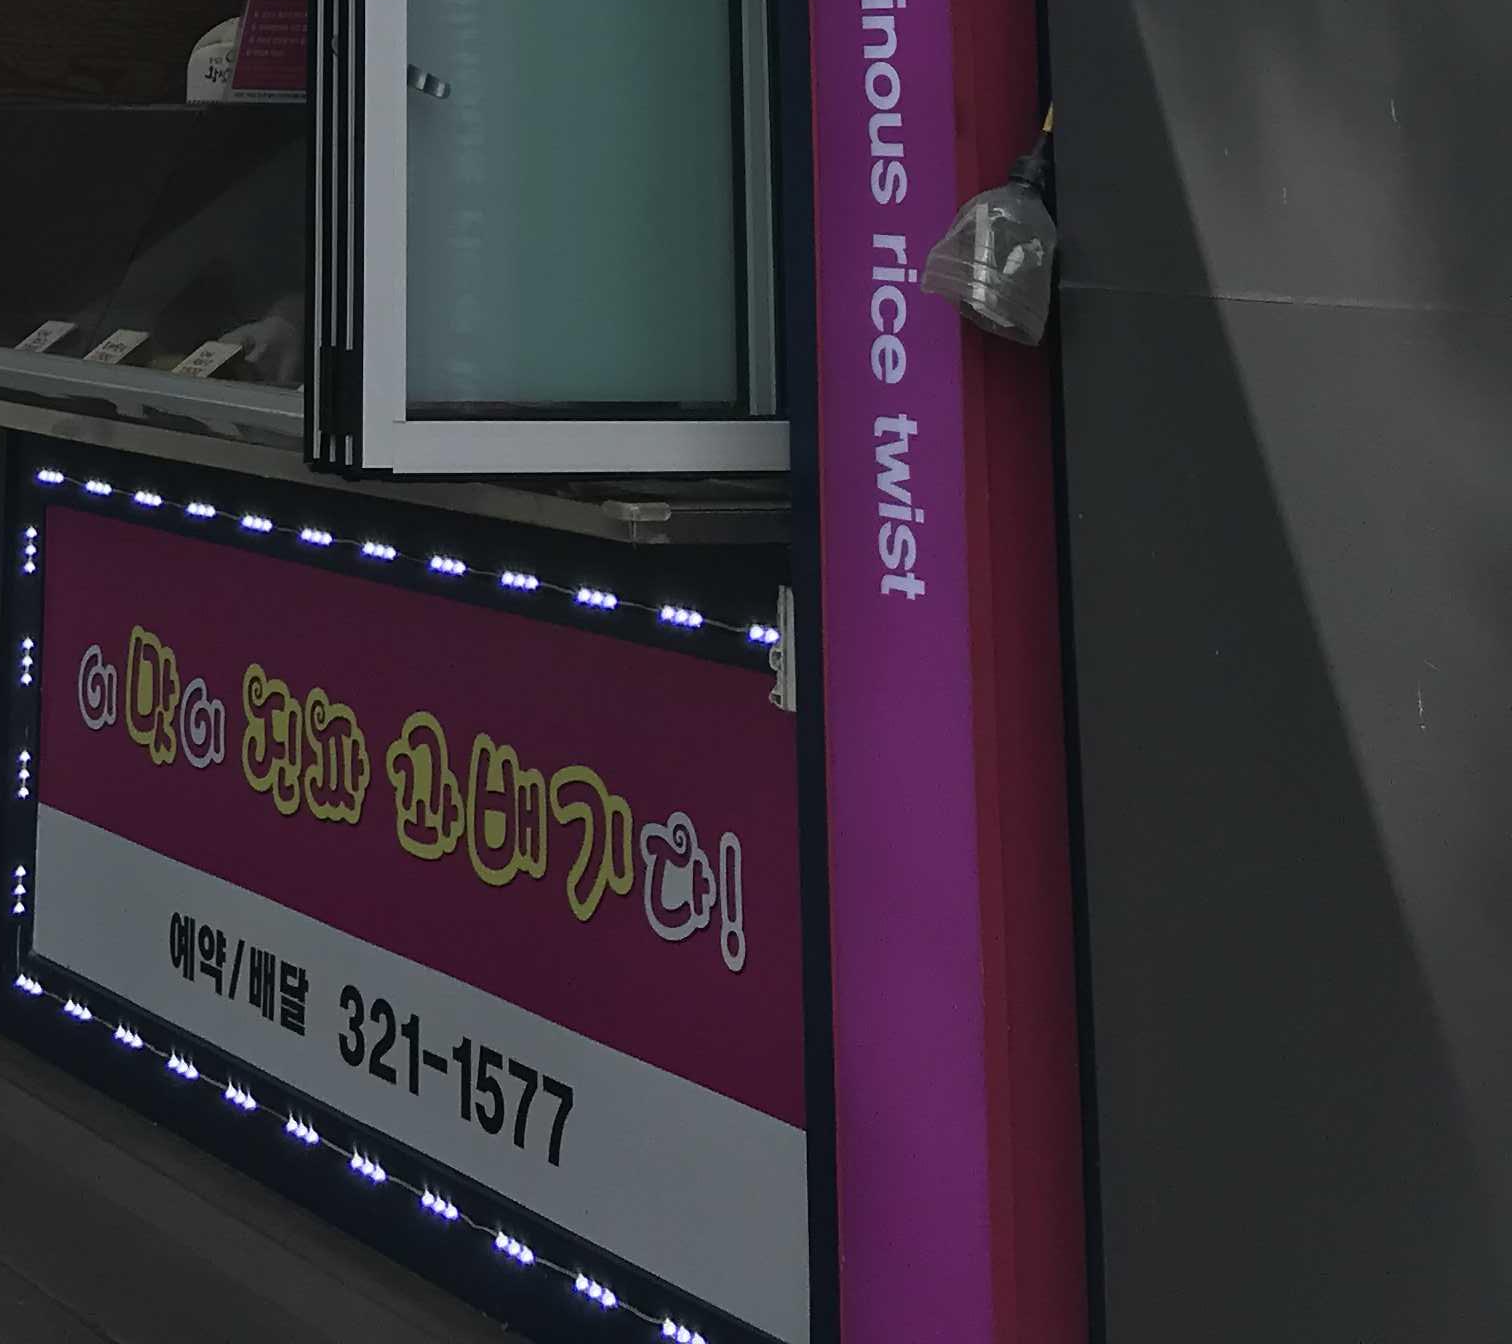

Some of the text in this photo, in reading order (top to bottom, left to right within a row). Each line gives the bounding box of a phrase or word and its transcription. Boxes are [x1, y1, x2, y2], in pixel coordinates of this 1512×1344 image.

[871, 233, 918, 384] rice
[874, 413, 925, 600] twist
[385, 710, 748, 973] 꽈배기다!
[168, 909, 576, 1169] 예약/배달 321-1577
